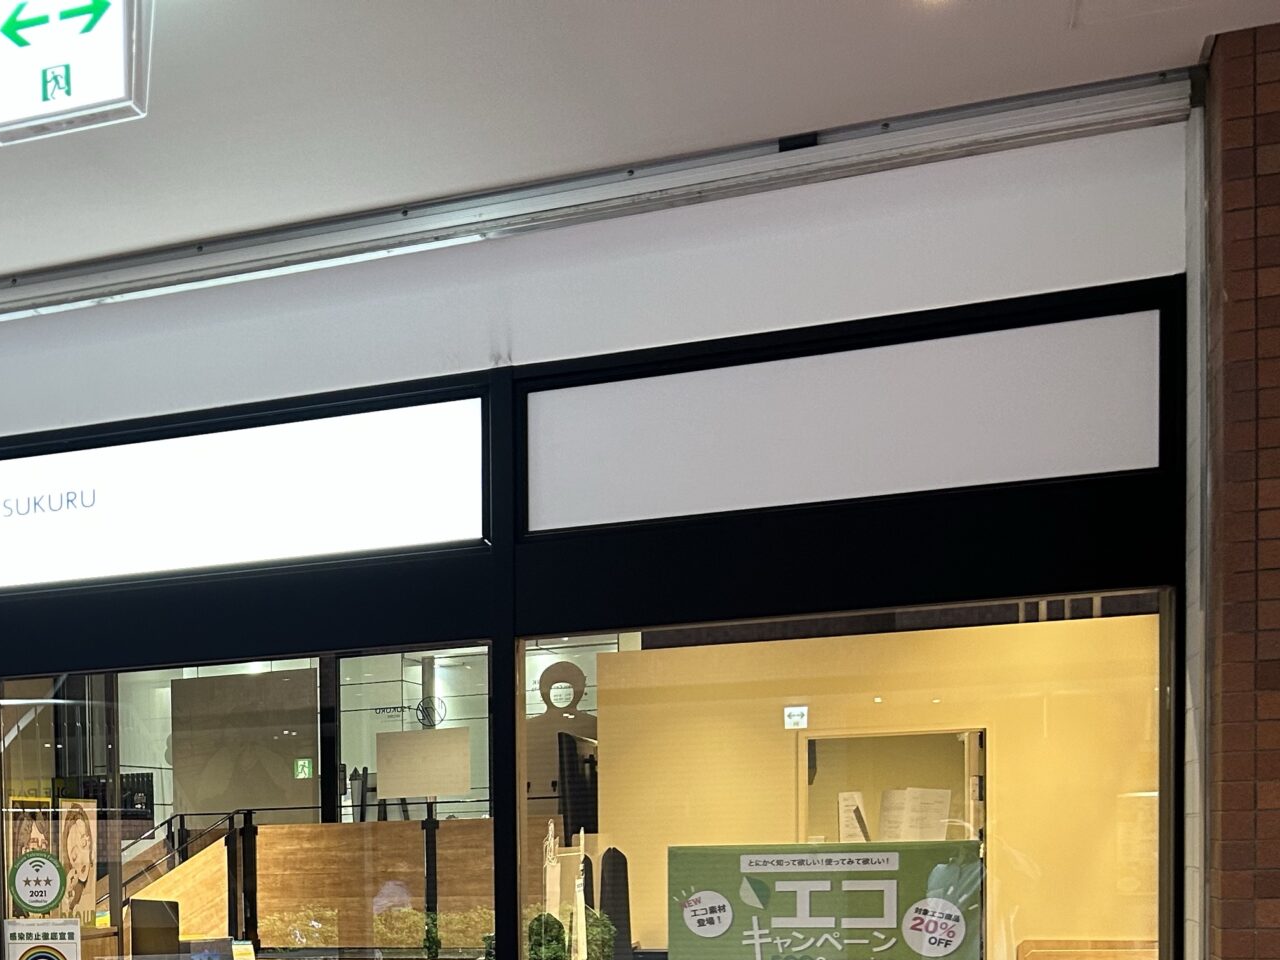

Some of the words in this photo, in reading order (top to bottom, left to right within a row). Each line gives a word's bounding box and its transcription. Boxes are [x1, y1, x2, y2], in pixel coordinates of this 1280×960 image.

[680, 896, 702, 909] NEW
[771, 880, 898, 928] エコ
[690, 904, 727, 917] エコ素材
[696, 916, 722, 928] 登場！
[910, 916, 956, 938] 20%
[9, 932, 76, 940] 感染防止徹底宣言
[928, 936, 953, 948] OFF
